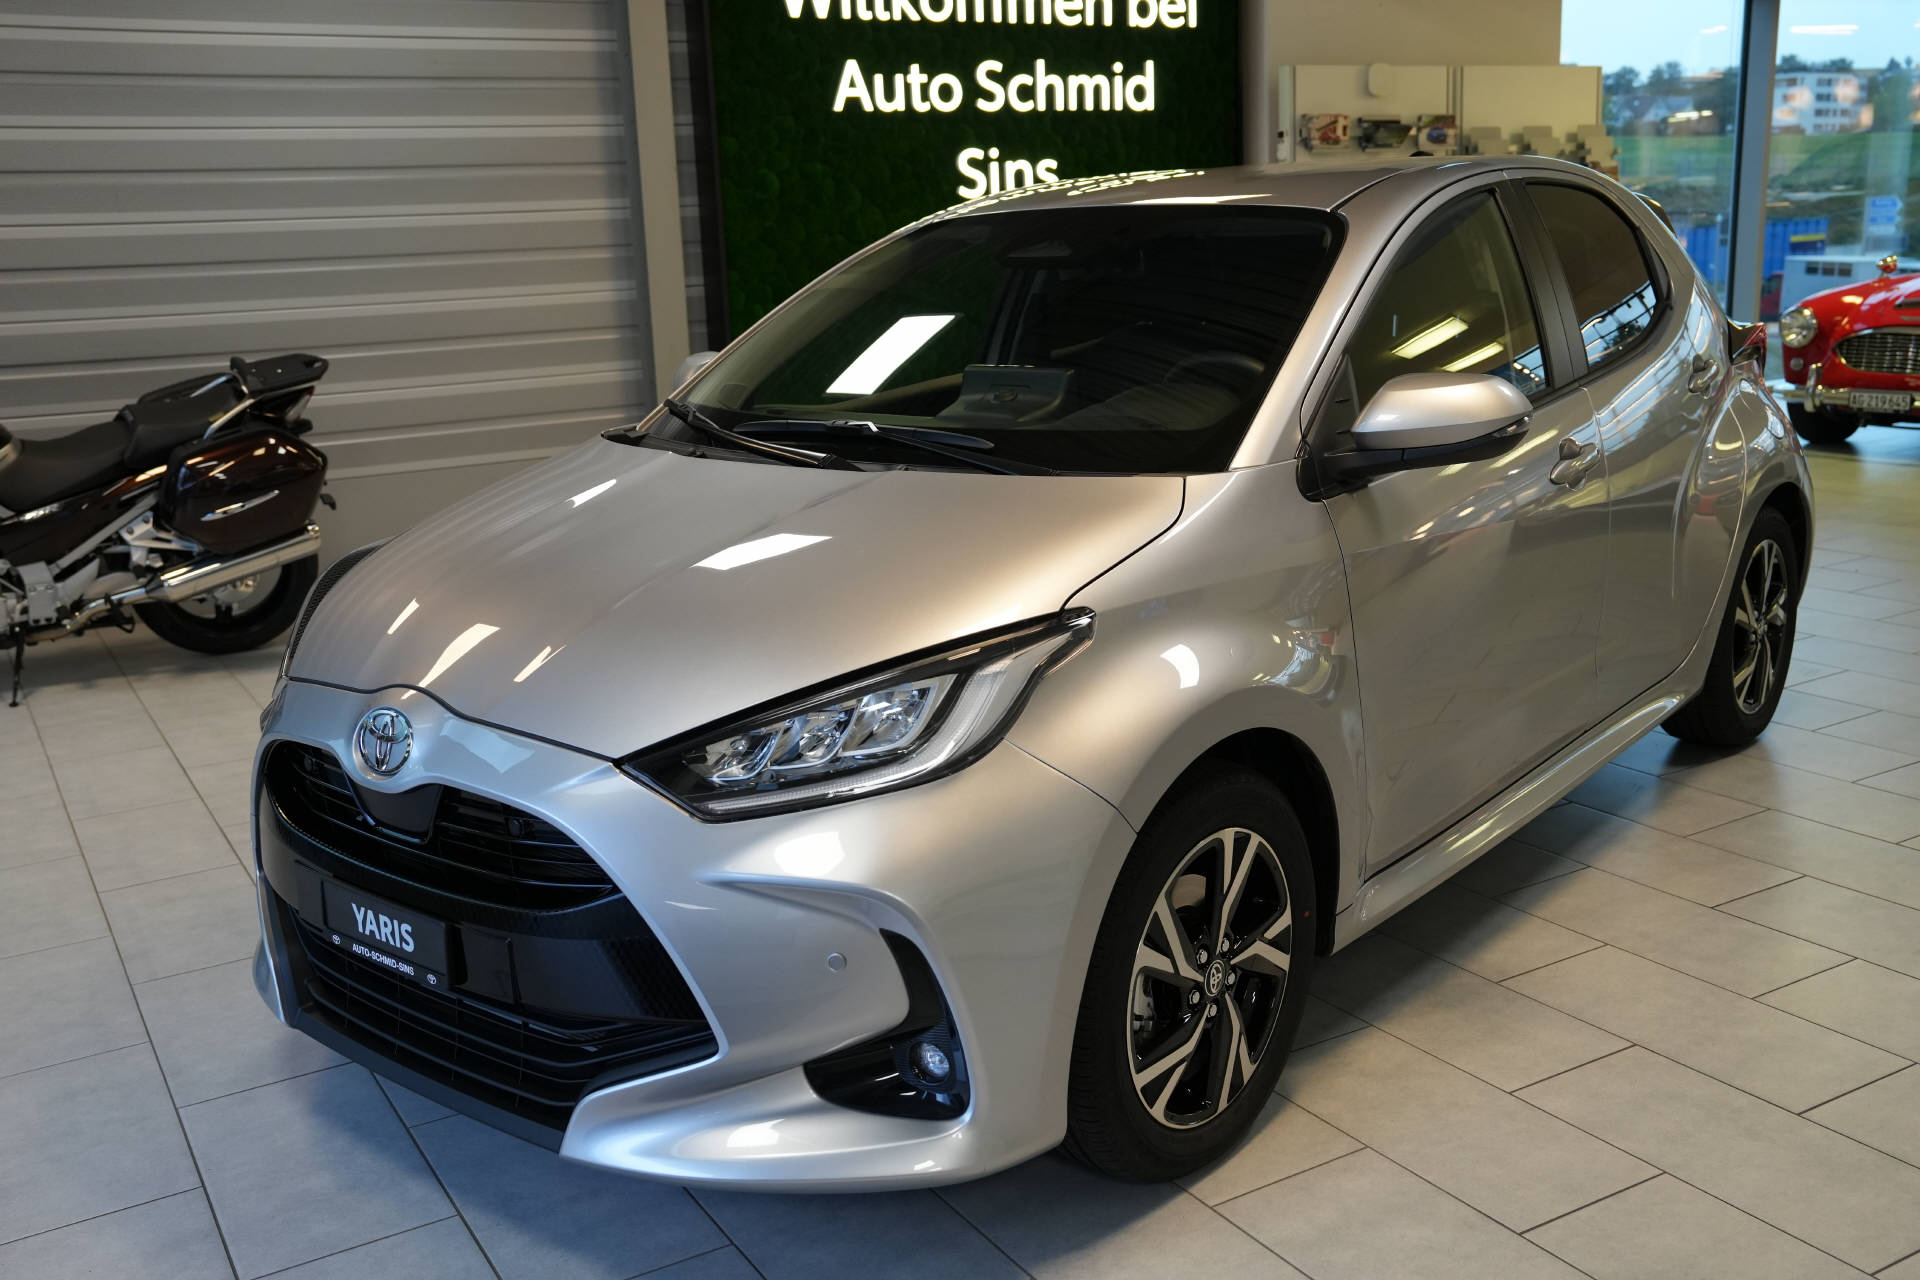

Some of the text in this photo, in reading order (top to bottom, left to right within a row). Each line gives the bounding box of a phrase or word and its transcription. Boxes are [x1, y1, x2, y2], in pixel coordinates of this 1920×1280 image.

[1127, 0, 1198, 28] bei
[832, 58, 1155, 113] Auto Schmid
[956, 147, 1059, 200] Sins
[350, 902, 415, 953] YARIS
[352, 943, 415, 976] AUTO-SCHMID-SINS
